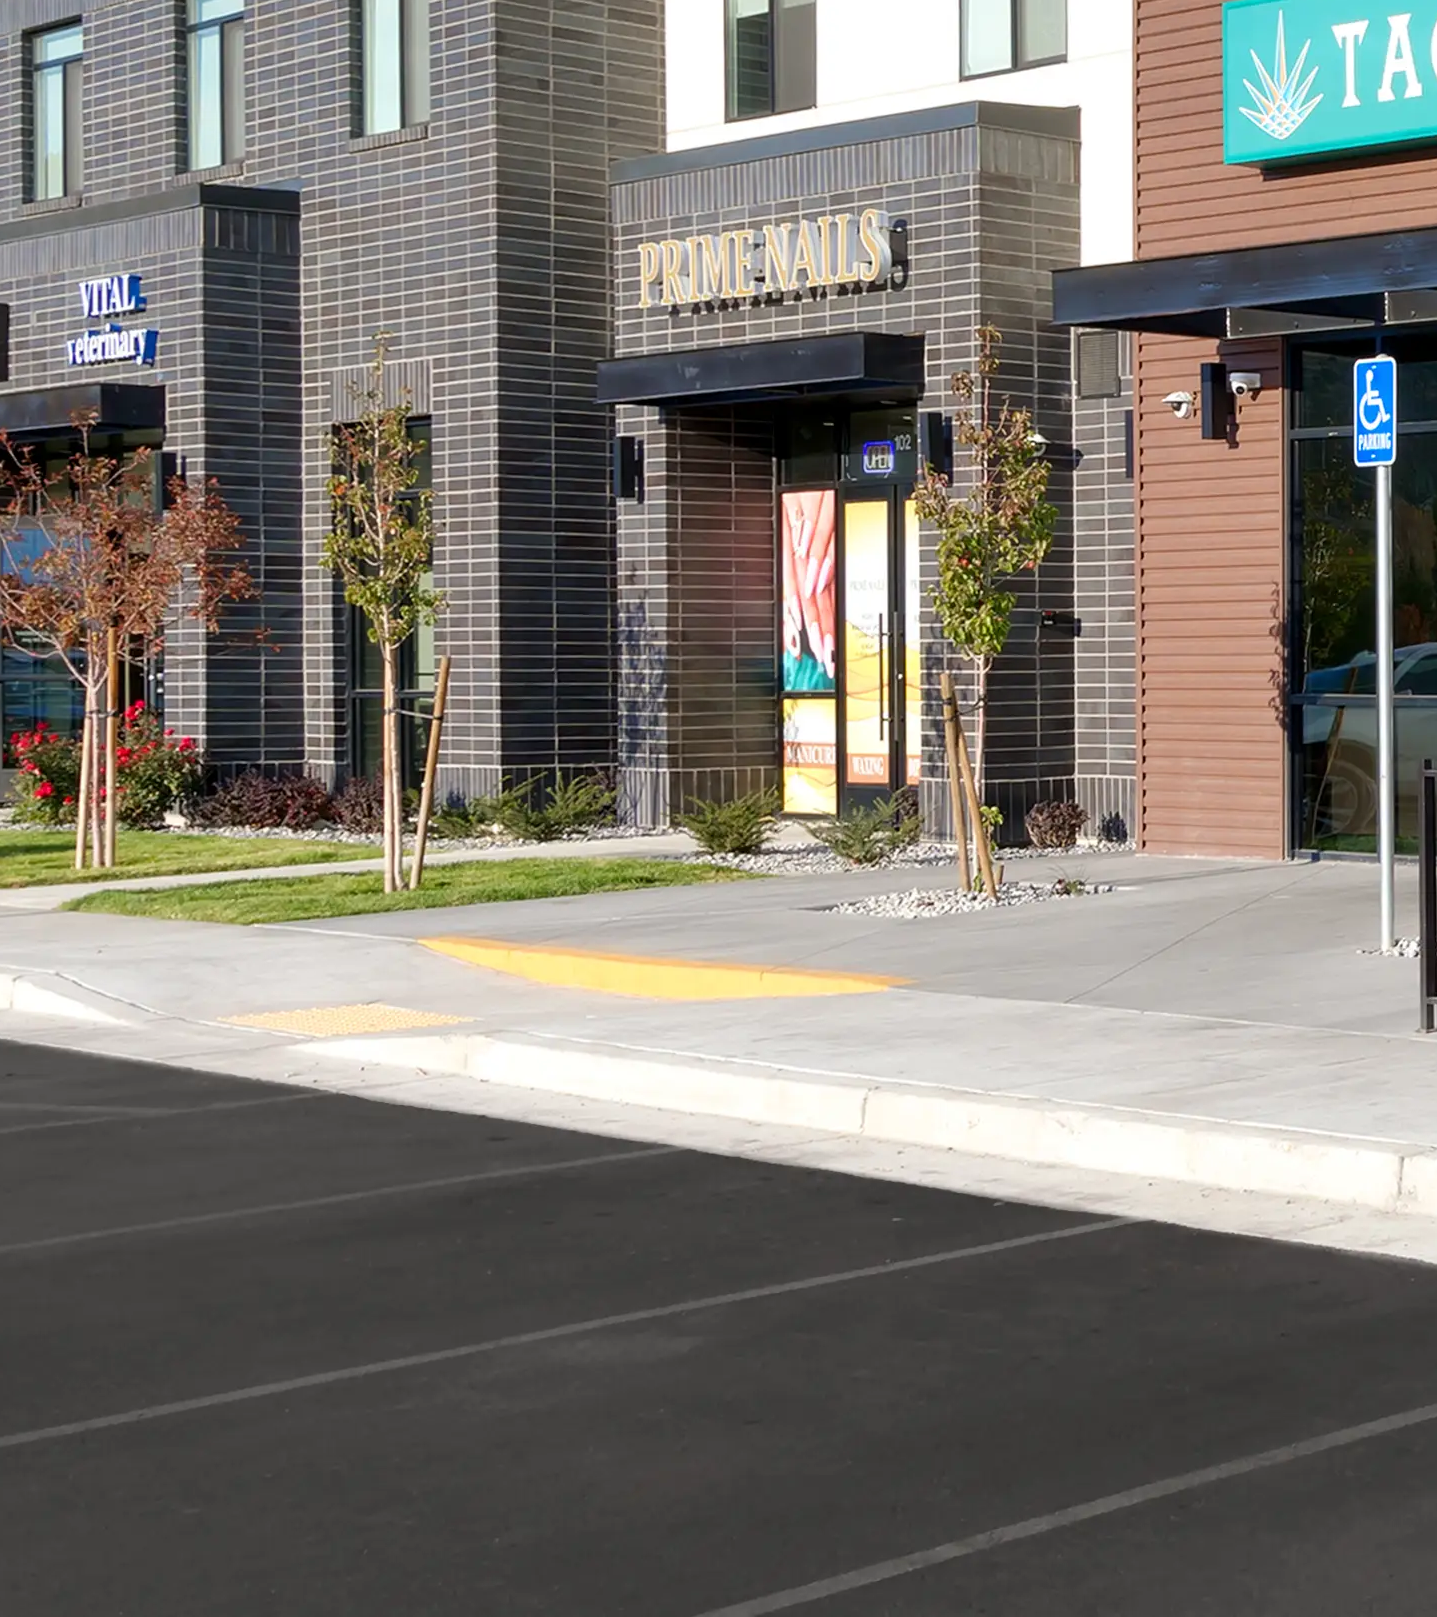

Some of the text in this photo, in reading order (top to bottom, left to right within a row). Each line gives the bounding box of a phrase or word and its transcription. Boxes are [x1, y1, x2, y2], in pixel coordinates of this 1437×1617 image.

[638, 208, 885, 309] PRIME NAILS
[79, 274, 139, 318] VITAL
[67, 323, 149, 366] veterinary
[894, 434, 911, 450] 102
[1359, 432, 1391, 451] PARKING
